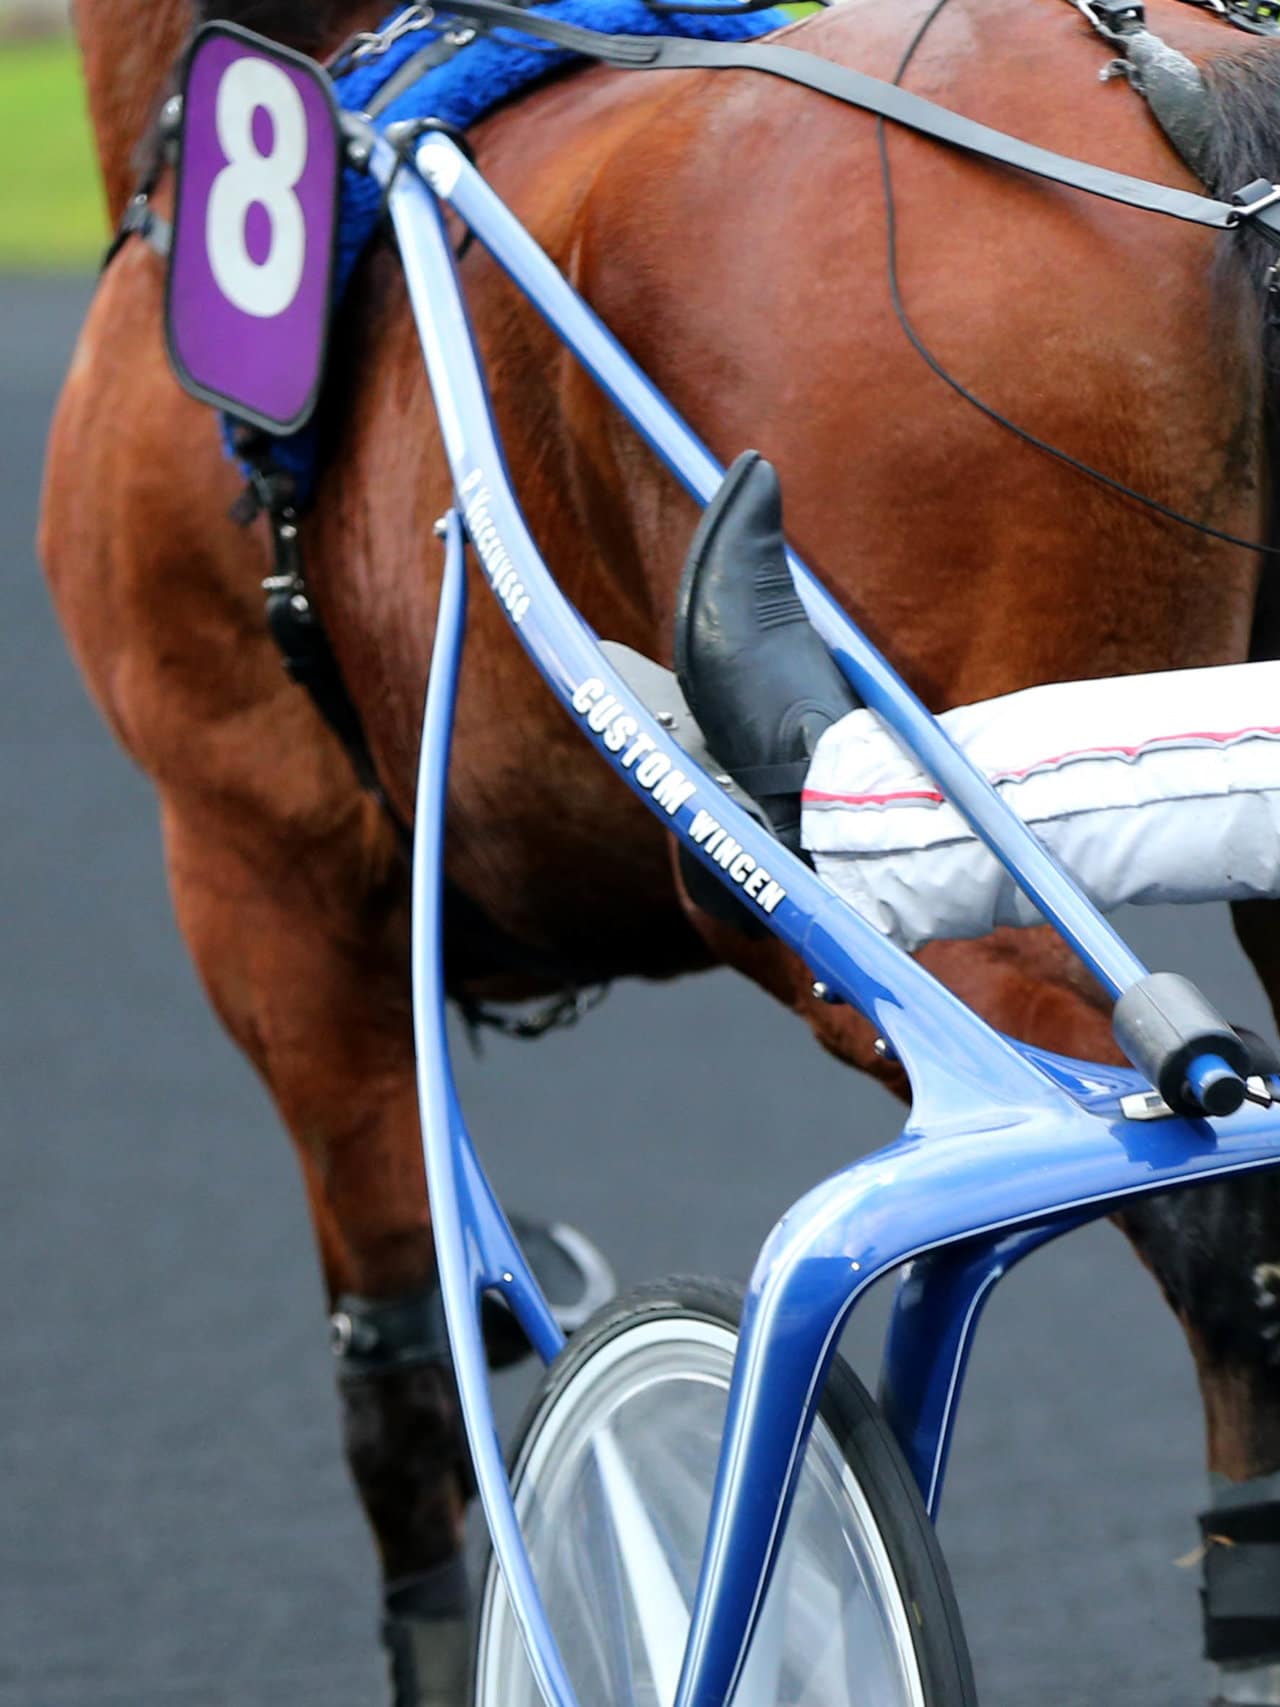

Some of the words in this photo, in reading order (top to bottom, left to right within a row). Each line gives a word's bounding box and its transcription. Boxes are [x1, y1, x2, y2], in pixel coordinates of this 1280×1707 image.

[205, 56, 309, 318] 8
[571, 678, 697, 816] CUSTOM
[688, 808, 787, 914] WINCEN
